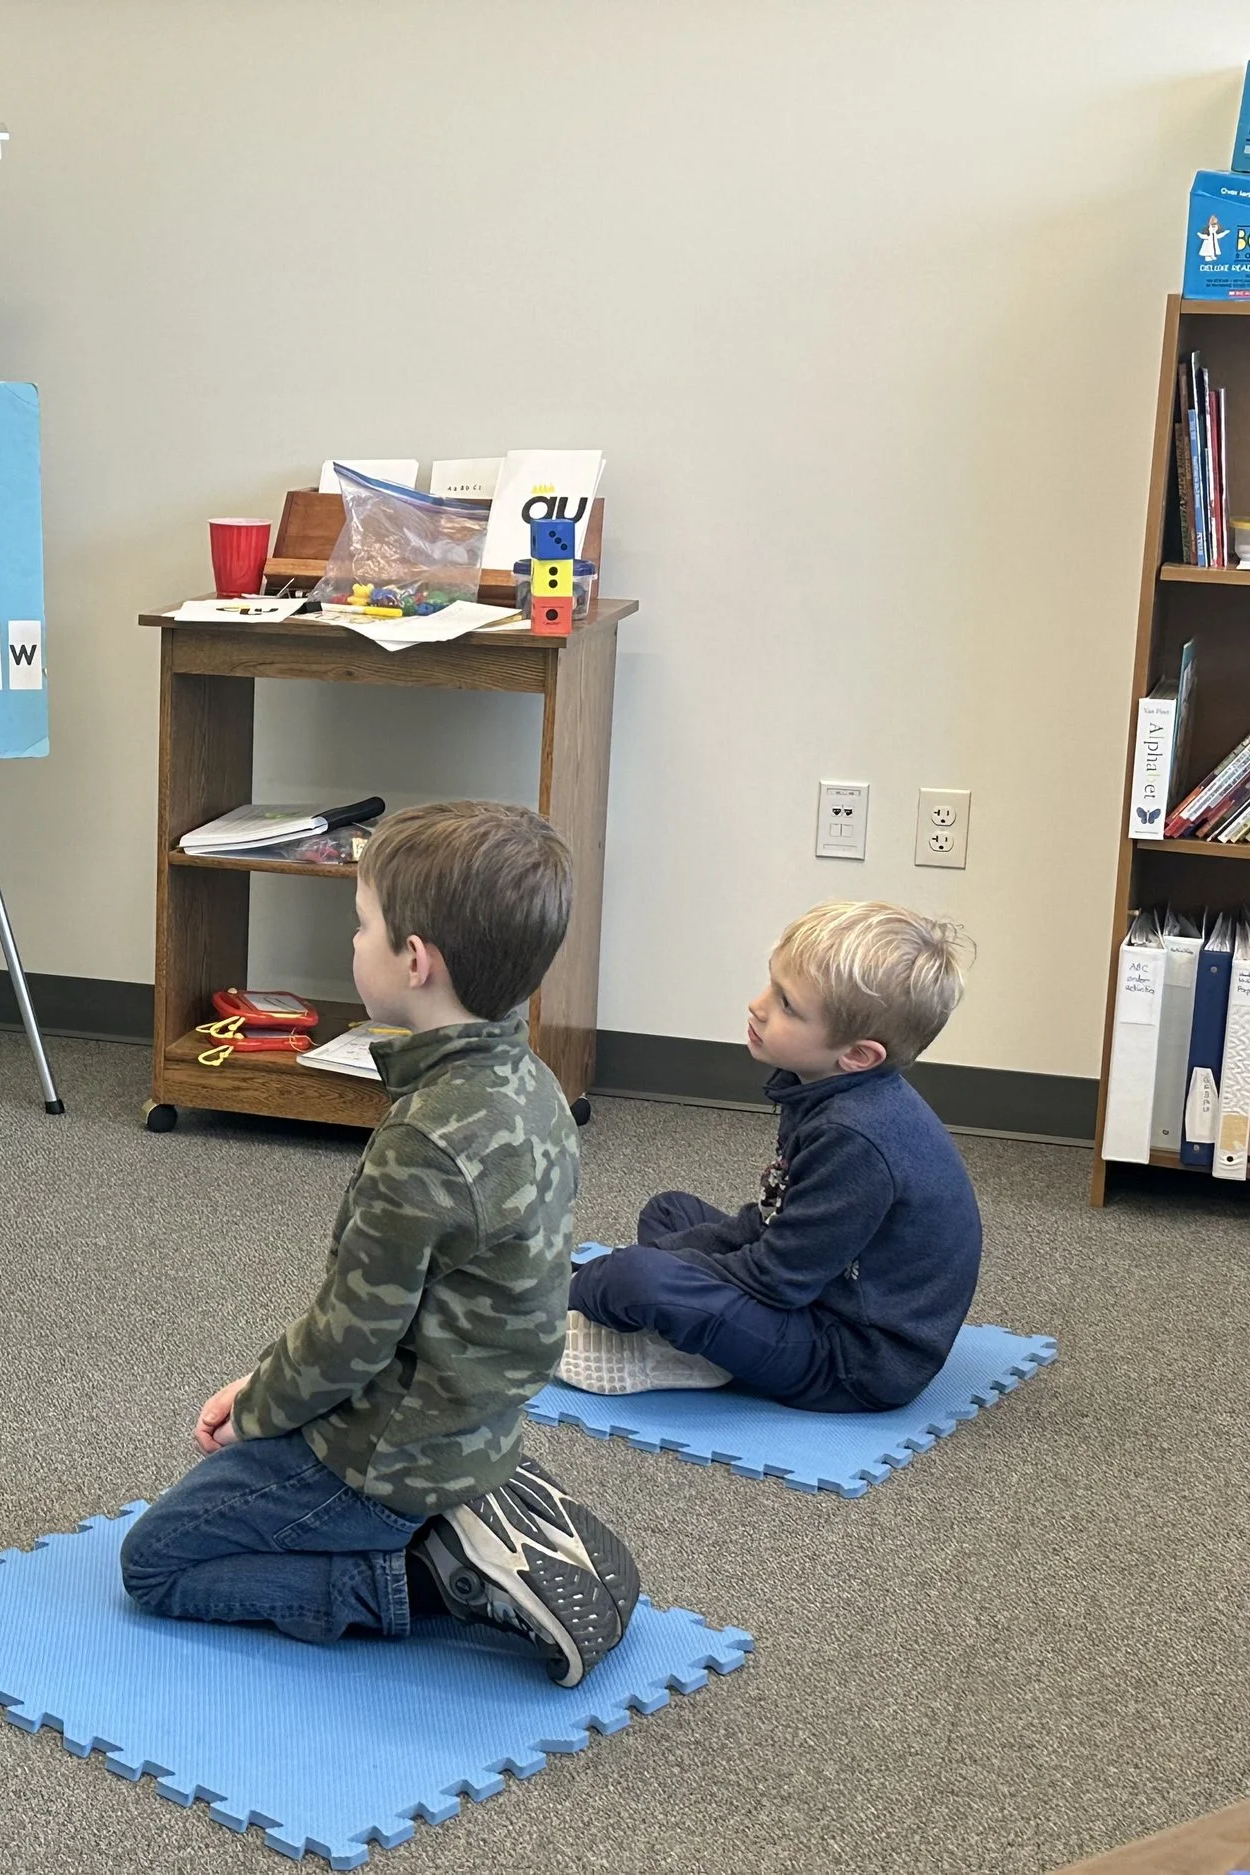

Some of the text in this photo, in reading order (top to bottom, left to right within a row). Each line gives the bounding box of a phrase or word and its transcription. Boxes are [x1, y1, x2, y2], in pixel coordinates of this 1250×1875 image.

[521, 495, 588, 525] au
[9, 644, 37, 666] w
[1143, 722, 1165, 800] Alphabet
